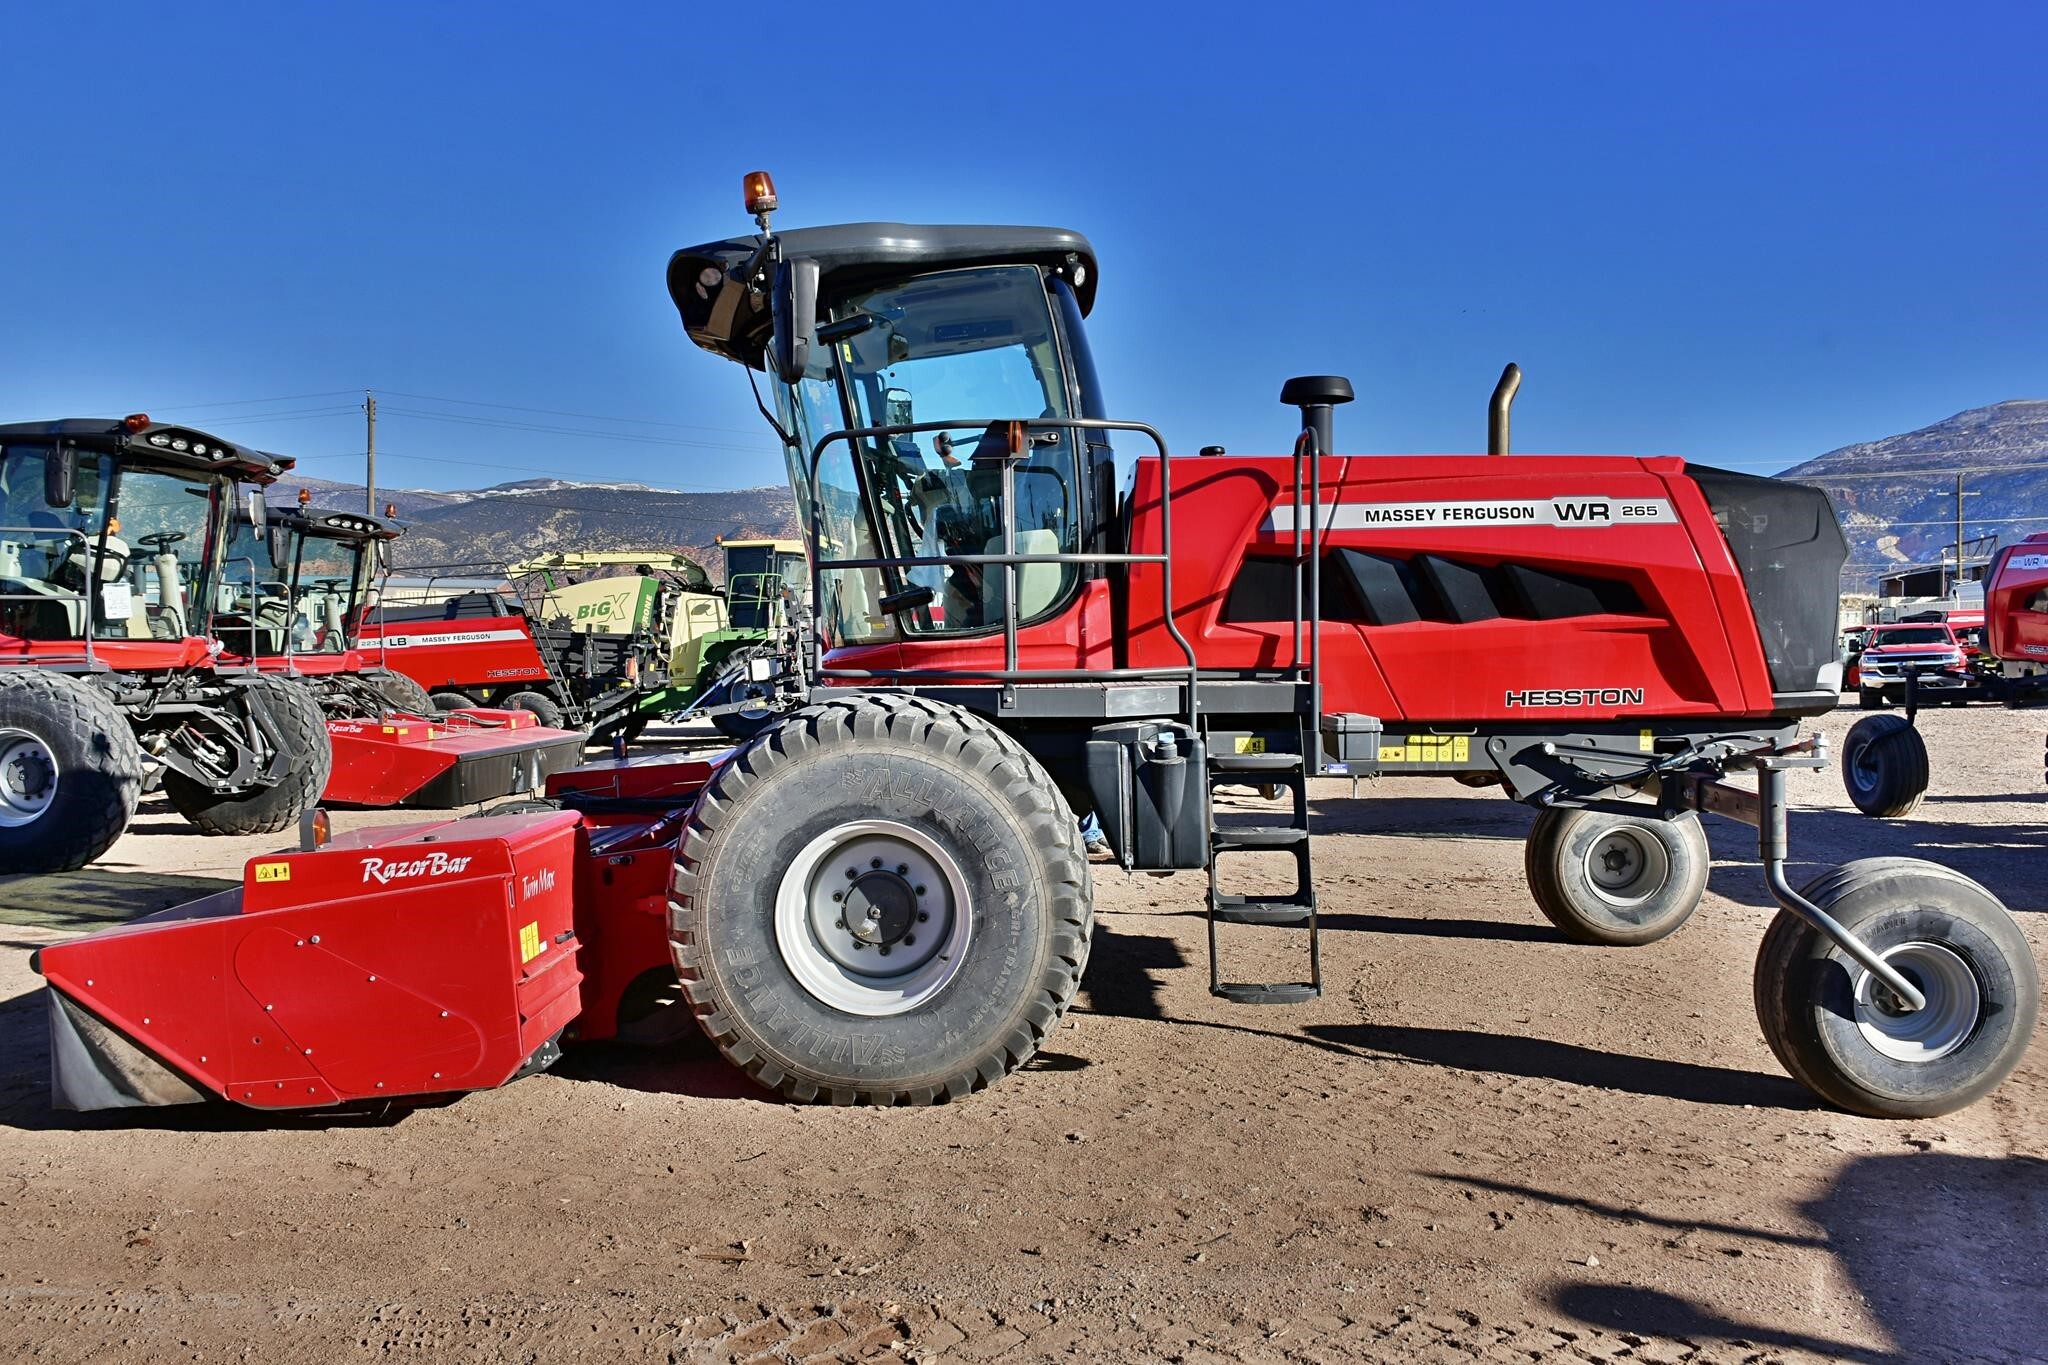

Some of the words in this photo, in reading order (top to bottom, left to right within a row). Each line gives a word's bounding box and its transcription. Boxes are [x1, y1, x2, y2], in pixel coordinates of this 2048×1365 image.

[1365, 508, 1437, 523] MASSEY
[1442, 506, 1535, 521] FERGUSON
[1553, 502, 1611, 521] WR
[1621, 505, 1660, 517] 265
[389, 637, 407, 647] LB
[421, 636, 450, 644] MASSEY
[453, 633, 491, 642] FERGUSON
[487, 667, 540, 678] HESSTON
[1505, 688, 1645, 707] HESSTON
[327, 722, 364, 733] RazorBar
[360, 852, 472, 885] RazorBar
